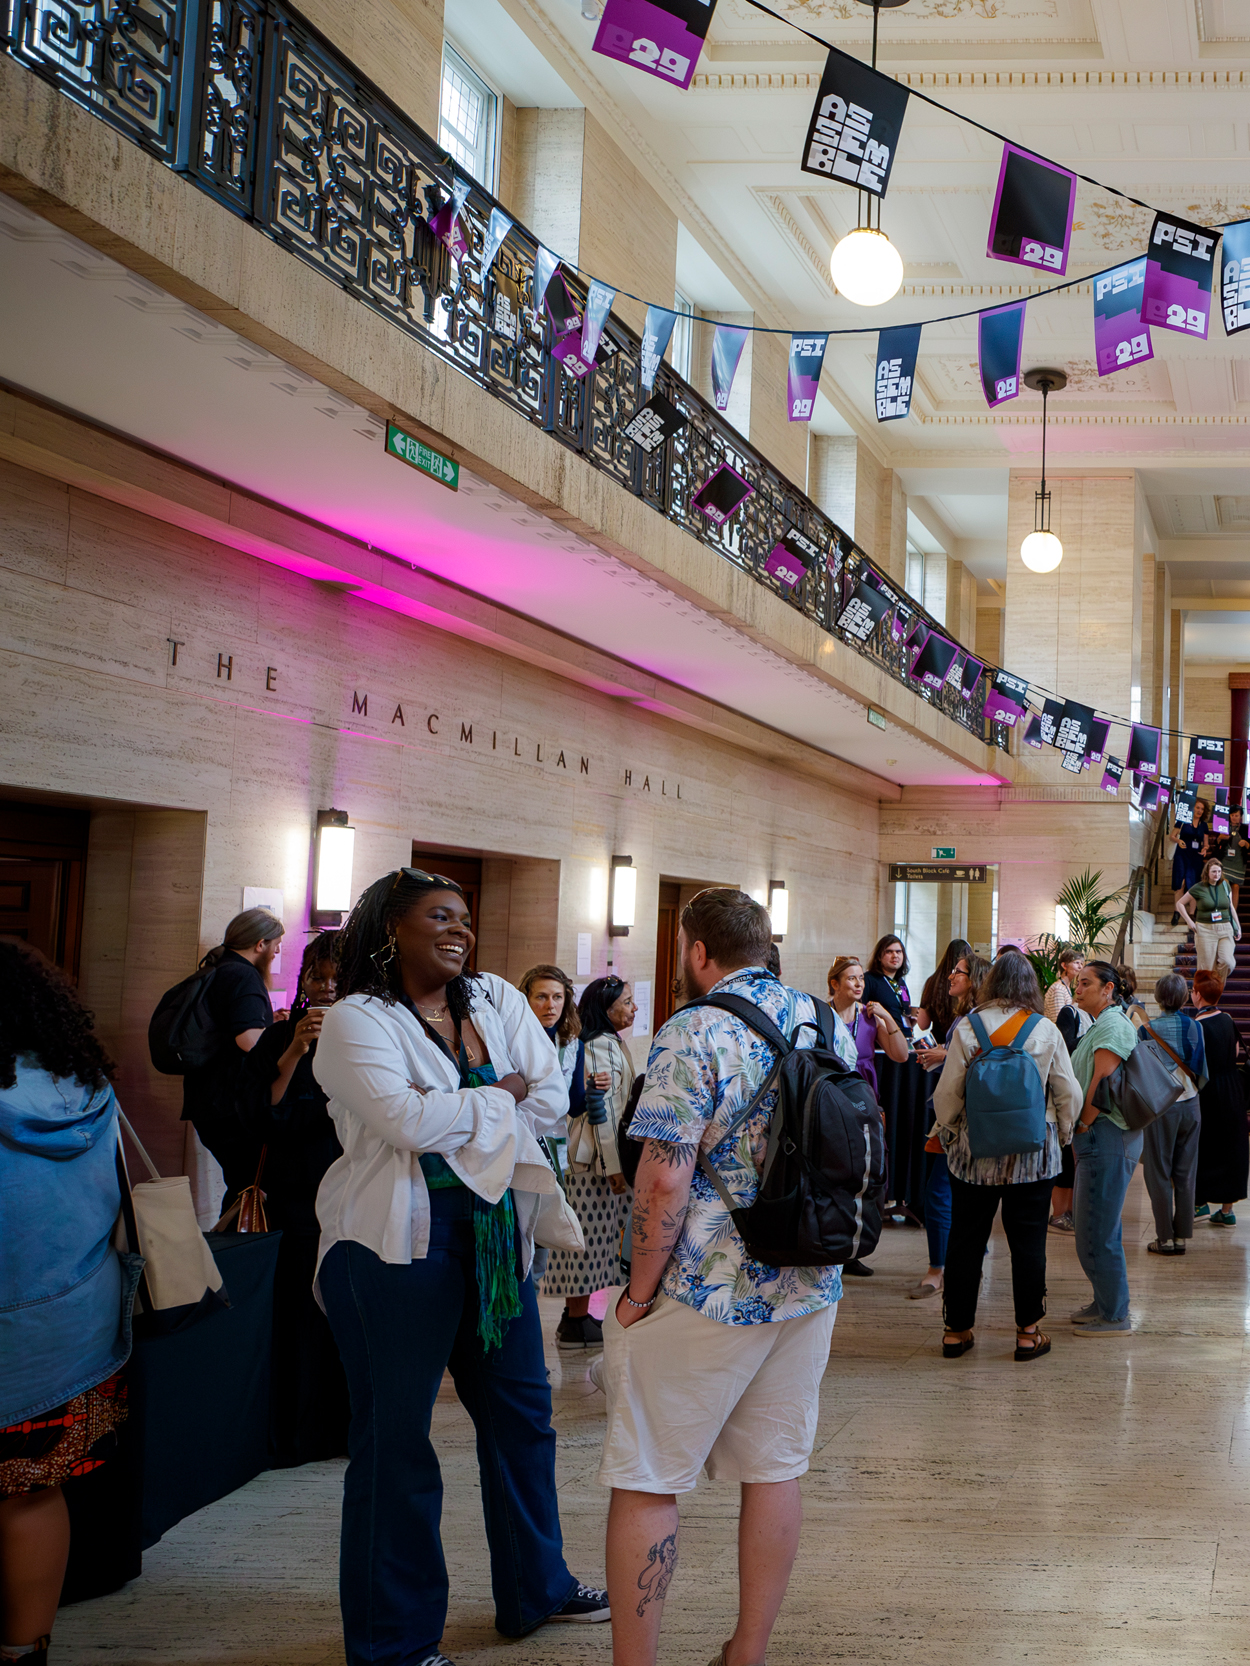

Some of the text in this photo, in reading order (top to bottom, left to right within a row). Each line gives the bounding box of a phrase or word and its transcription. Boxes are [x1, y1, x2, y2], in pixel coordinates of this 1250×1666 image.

[629, 38, 690, 82] 29
[819, 93, 873, 135] AS
[813, 116, 890, 170] SEM
[806, 141, 885, 193] BLE
[1153, 221, 1214, 261] PSI
[1023, 242, 1063, 270] 29
[1097, 264, 1144, 301] PSI
[589, 285, 615, 309] PSI
[566, 317, 581, 330] 29
[1167, 304, 1206, 334] 29
[791, 339, 825, 357] PSI
[1116, 333, 1149, 365] 29
[563, 354, 588, 376] 29
[878, 358, 902, 379] AS
[876, 376, 911, 399] SEM
[997, 376, 1016, 400] 29
[717, 393, 728, 407] 29
[793, 399, 812, 417] 29
[876, 396, 909, 419] BLE
[640, 408, 664, 430] AS
[625, 423, 657, 452] BLE
[634, 415, 664, 446] SEM
[418, 455, 431, 470] EXIT
[419, 446, 431, 462] FIRE
[705, 505, 725, 523] 29
[787, 529, 819, 557] PSI
[775, 566, 799, 585] 29
[881, 584, 898, 603] PSI
[849, 598, 872, 612] AS
[837, 614, 871, 640] BLE
[843, 606, 875, 631] SEM
[924, 674, 942, 688] 29
[996, 673, 1026, 693] PSI
[167, 638, 683, 800] THE MACMILLAN HALL
[994, 710, 1016, 725] 29
[1061, 717, 1081, 730] AS
[1058, 727, 1087, 743] SEM
[1198, 739, 1224, 751] PSI
[1055, 737, 1085, 754] BLE
[1091, 752, 1101, 761] 29
[1107, 763, 1122, 775] PSI
[1141, 762, 1156, 772] 29
[1204, 773, 1223, 783] 29
[1215, 805, 1229, 814] PSI
